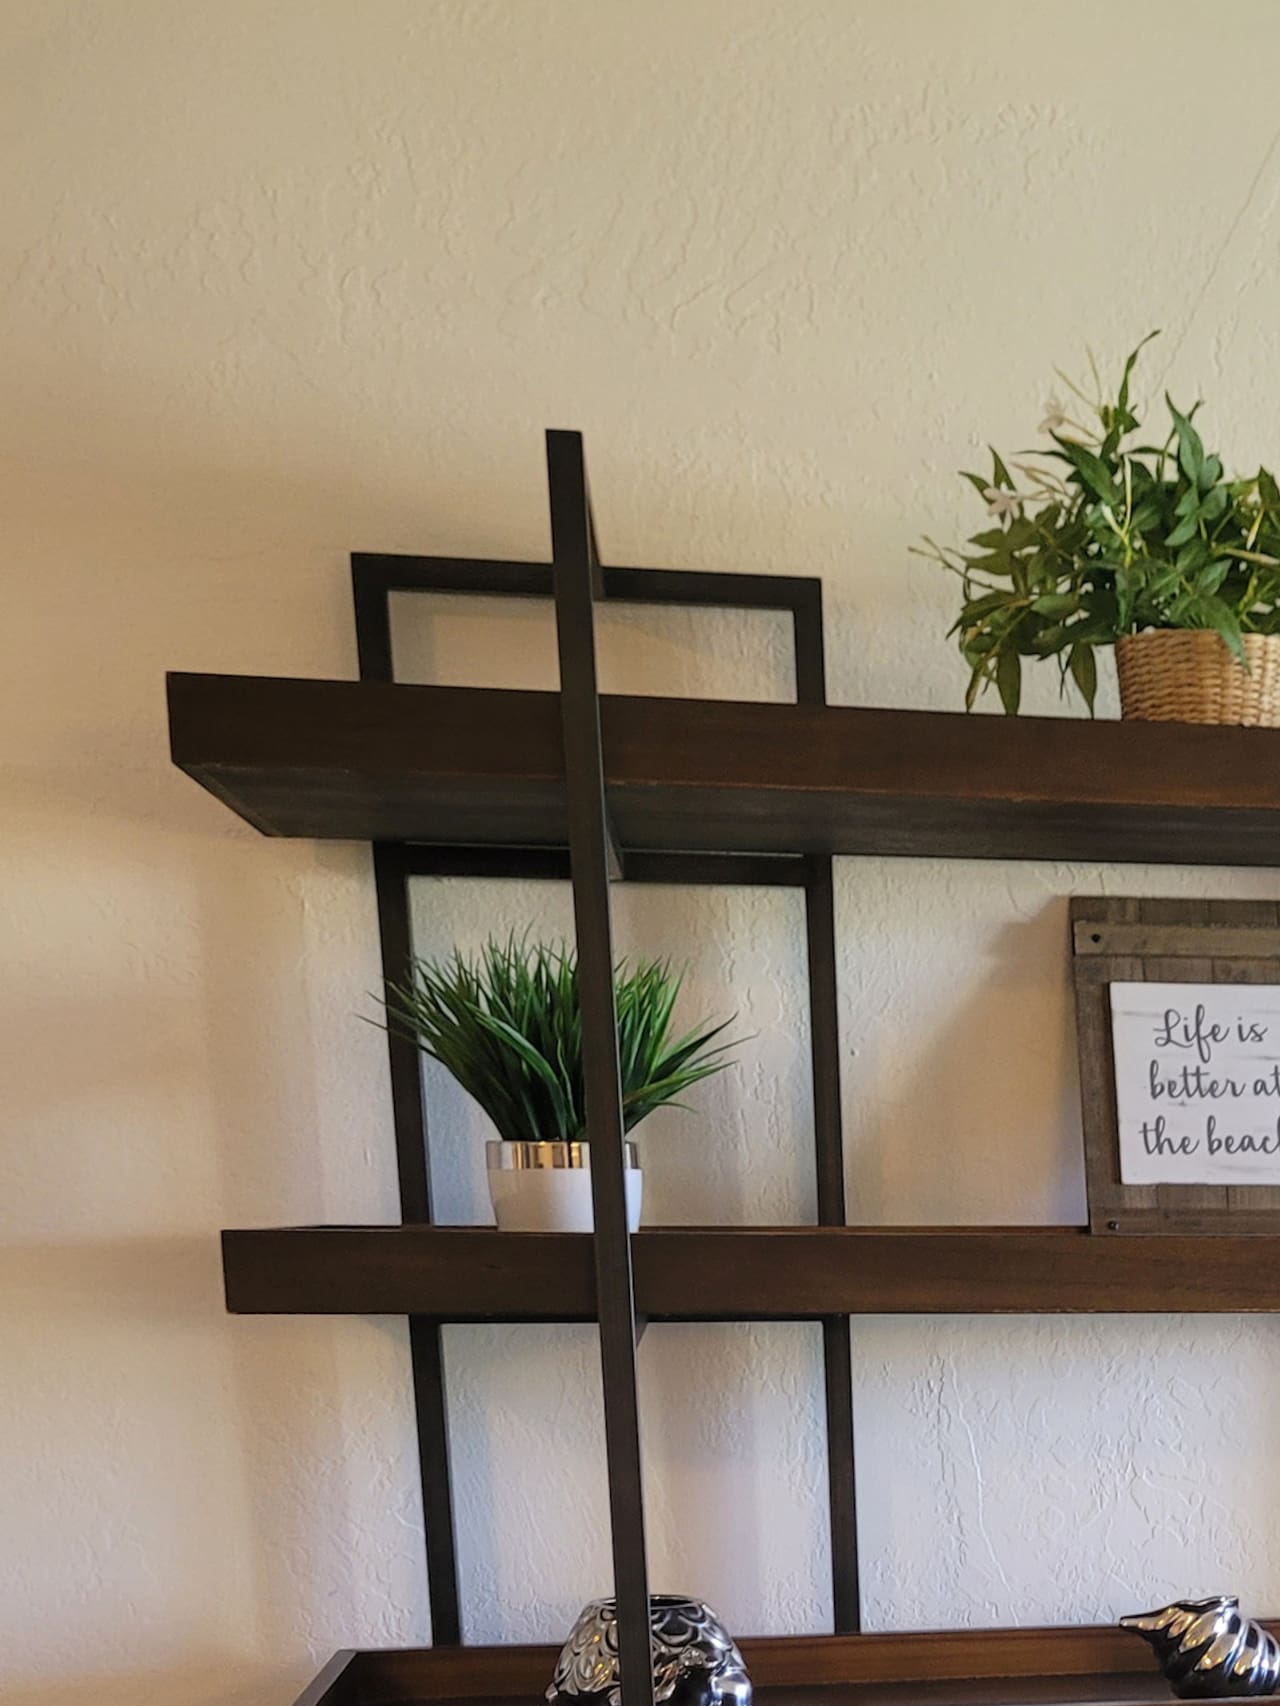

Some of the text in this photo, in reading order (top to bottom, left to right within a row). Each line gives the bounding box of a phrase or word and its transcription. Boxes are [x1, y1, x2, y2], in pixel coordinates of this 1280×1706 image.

[1153, 1004, 1268, 1064] Life is
[1149, 1059, 1246, 1100] better
[1138, 1115, 1200, 1155] the
